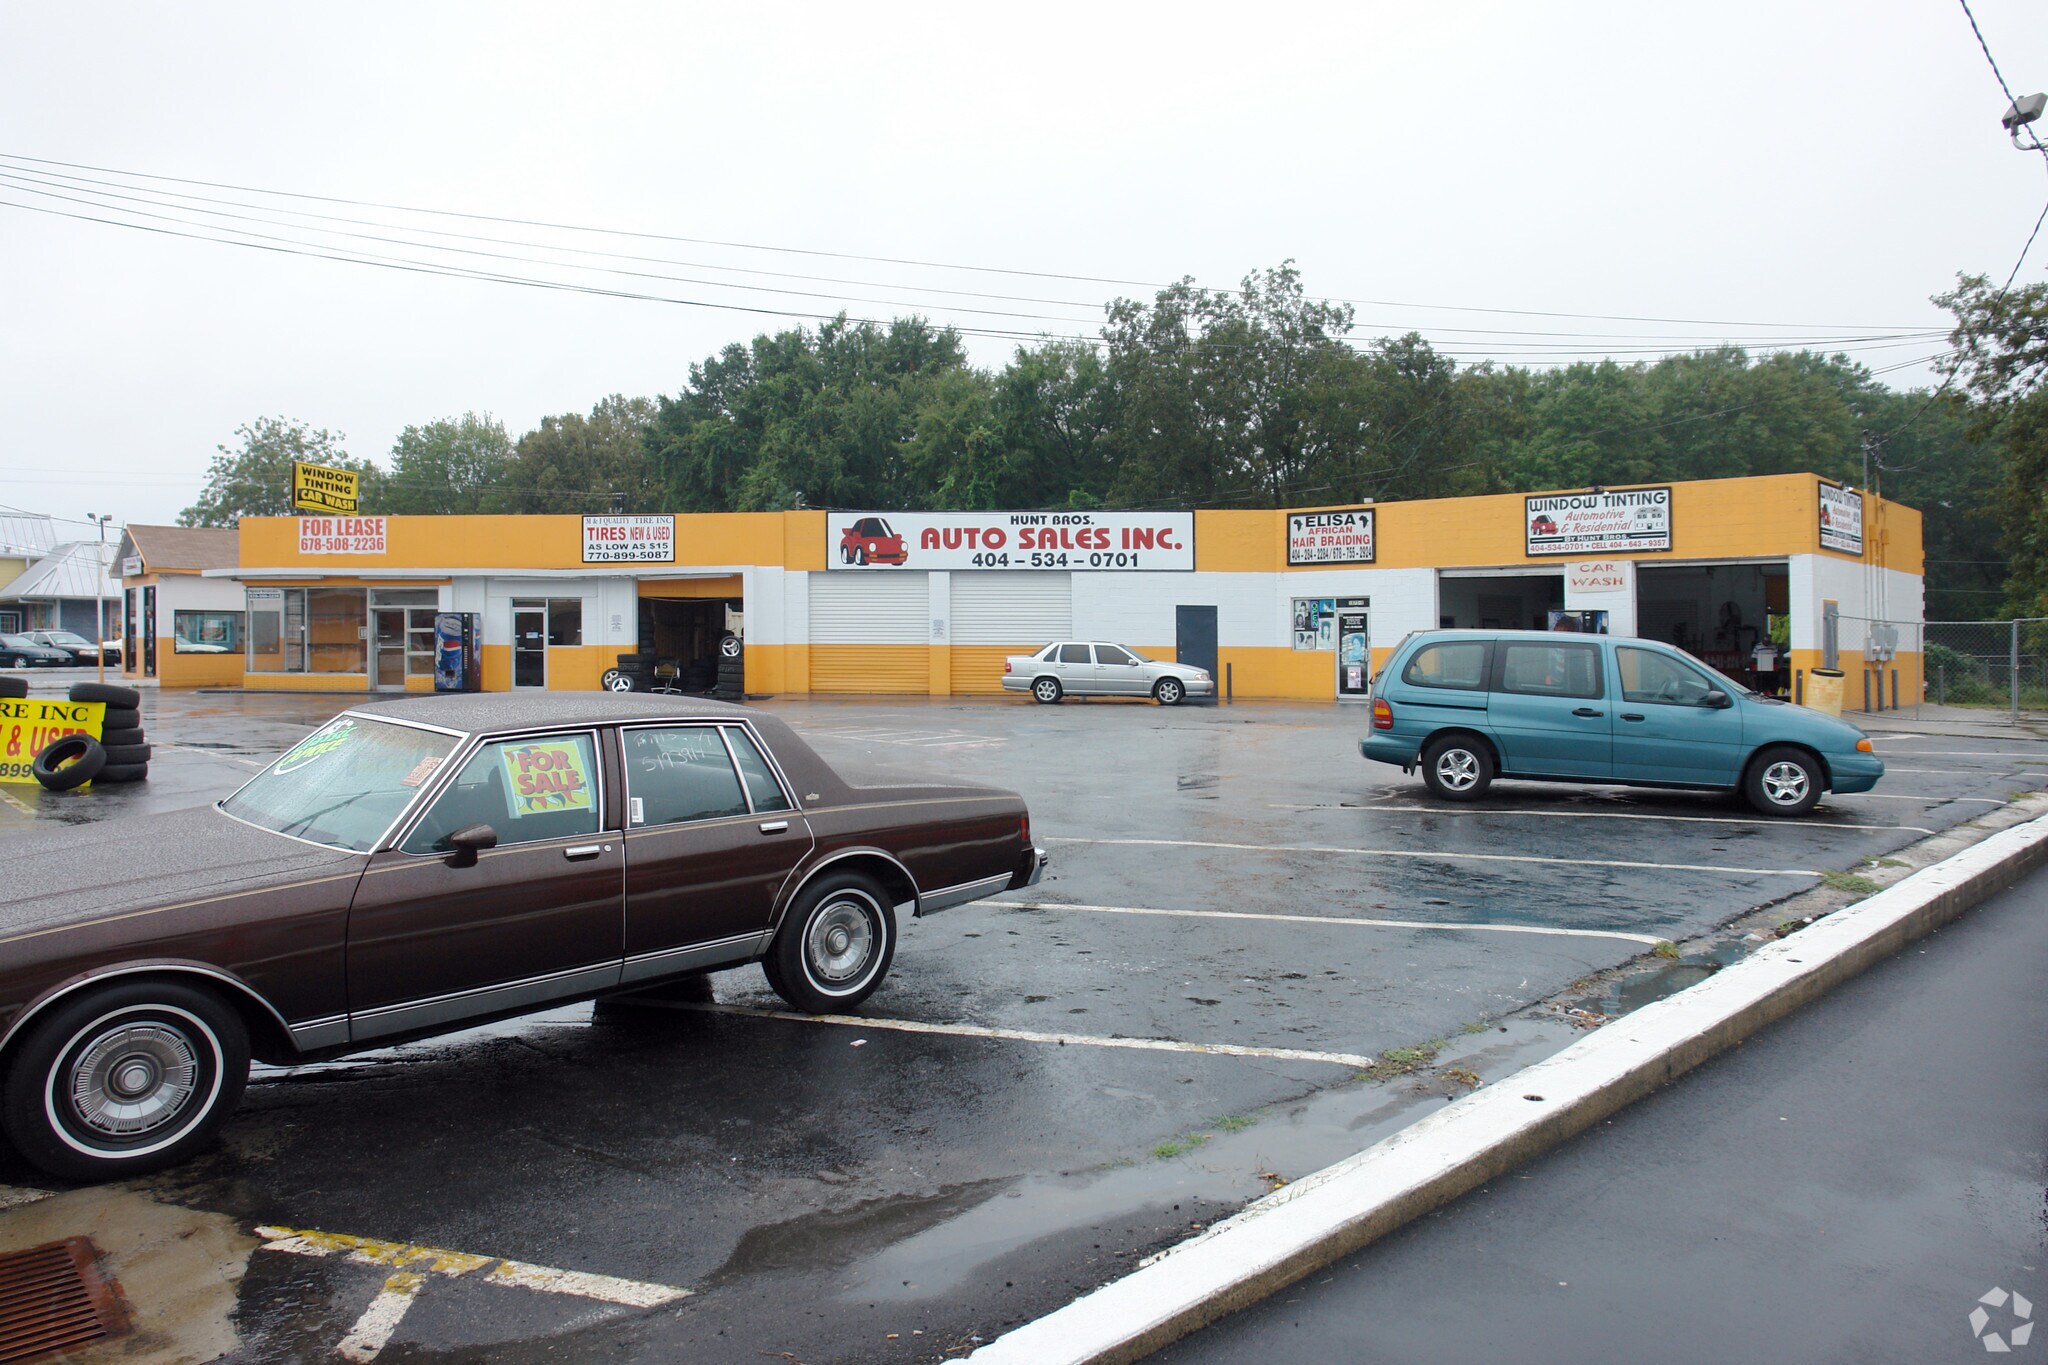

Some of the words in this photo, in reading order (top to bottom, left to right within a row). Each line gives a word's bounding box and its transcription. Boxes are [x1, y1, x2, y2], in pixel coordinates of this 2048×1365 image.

[301, 466, 354, 484] WINDOW
[304, 478, 351, 495] TINTING
[301, 489, 323, 503] CAR
[325, 494, 354, 511] WASH
[1529, 496, 1597, 512] WINDOW
[1603, 492, 1666, 507] TINTING
[603, 517, 630, 525] QUALITY
[1010, 515, 1048, 525] HUNT
[1052, 515, 1095, 525] BROS.
[1305, 514, 1356, 527] ELISA
[1565, 509, 1625, 521] Automotive
[302, 519, 332, 536] FOR
[337, 519, 383, 536] LEASE
[587, 527, 626, 541] TIRES
[630, 526, 645, 540] NEW
[646, 526, 651, 540] &
[653, 526, 670, 540] USED
[1308, 526, 1353, 535] AFRICAN
[1561, 523, 1570, 533] &
[1572, 520, 1632, 533] Residential
[301, 537, 384, 551] 678-508-2236
[920, 527, 1007, 550] AUTO
[1018, 527, 1111, 550] SALES
[1121, 527, 1183, 550] INC.
[1292, 537, 1316, 548] HAIR
[1321, 534, 1370, 547] BRAIDING
[649, 542, 669, 550] $15
[1530, 542, 1584, 552] 404-534-0701
[587, 551, 669, 560] 770-899-5087
[1580, 564, 1615, 573] CAR
[1571, 577, 1624, 587] WASH
[39, 705, 89, 722] INC
[6, 724, 21, 757] &
[517, 750, 572, 773] FOR
[517, 769, 581, 795] SALE
